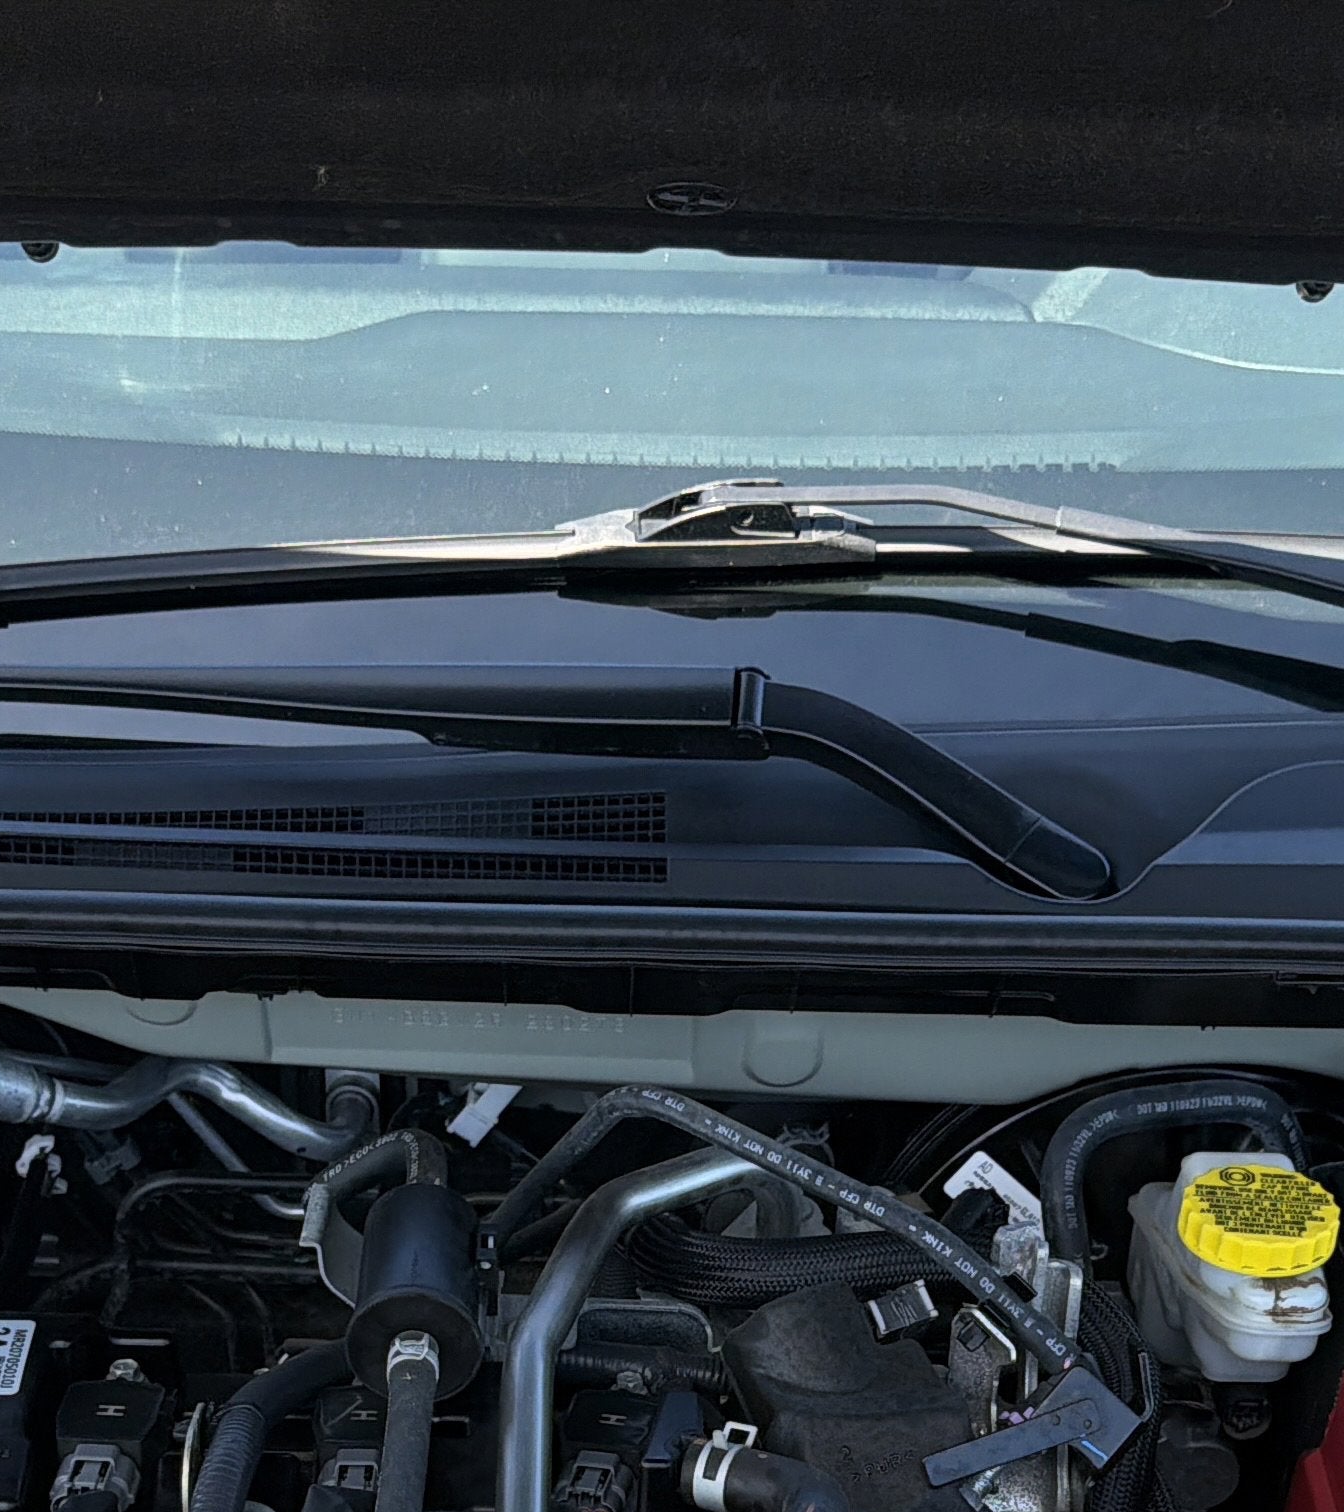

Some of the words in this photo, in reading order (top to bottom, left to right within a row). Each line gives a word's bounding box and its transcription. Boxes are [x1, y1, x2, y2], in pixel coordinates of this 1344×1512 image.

[743, 1139, 763, 1156] NOT
[863, 1199, 886, 1217] DTR
[921, 1230, 954, 1257] KINK
[953, 1256, 978, 1279] NOT
